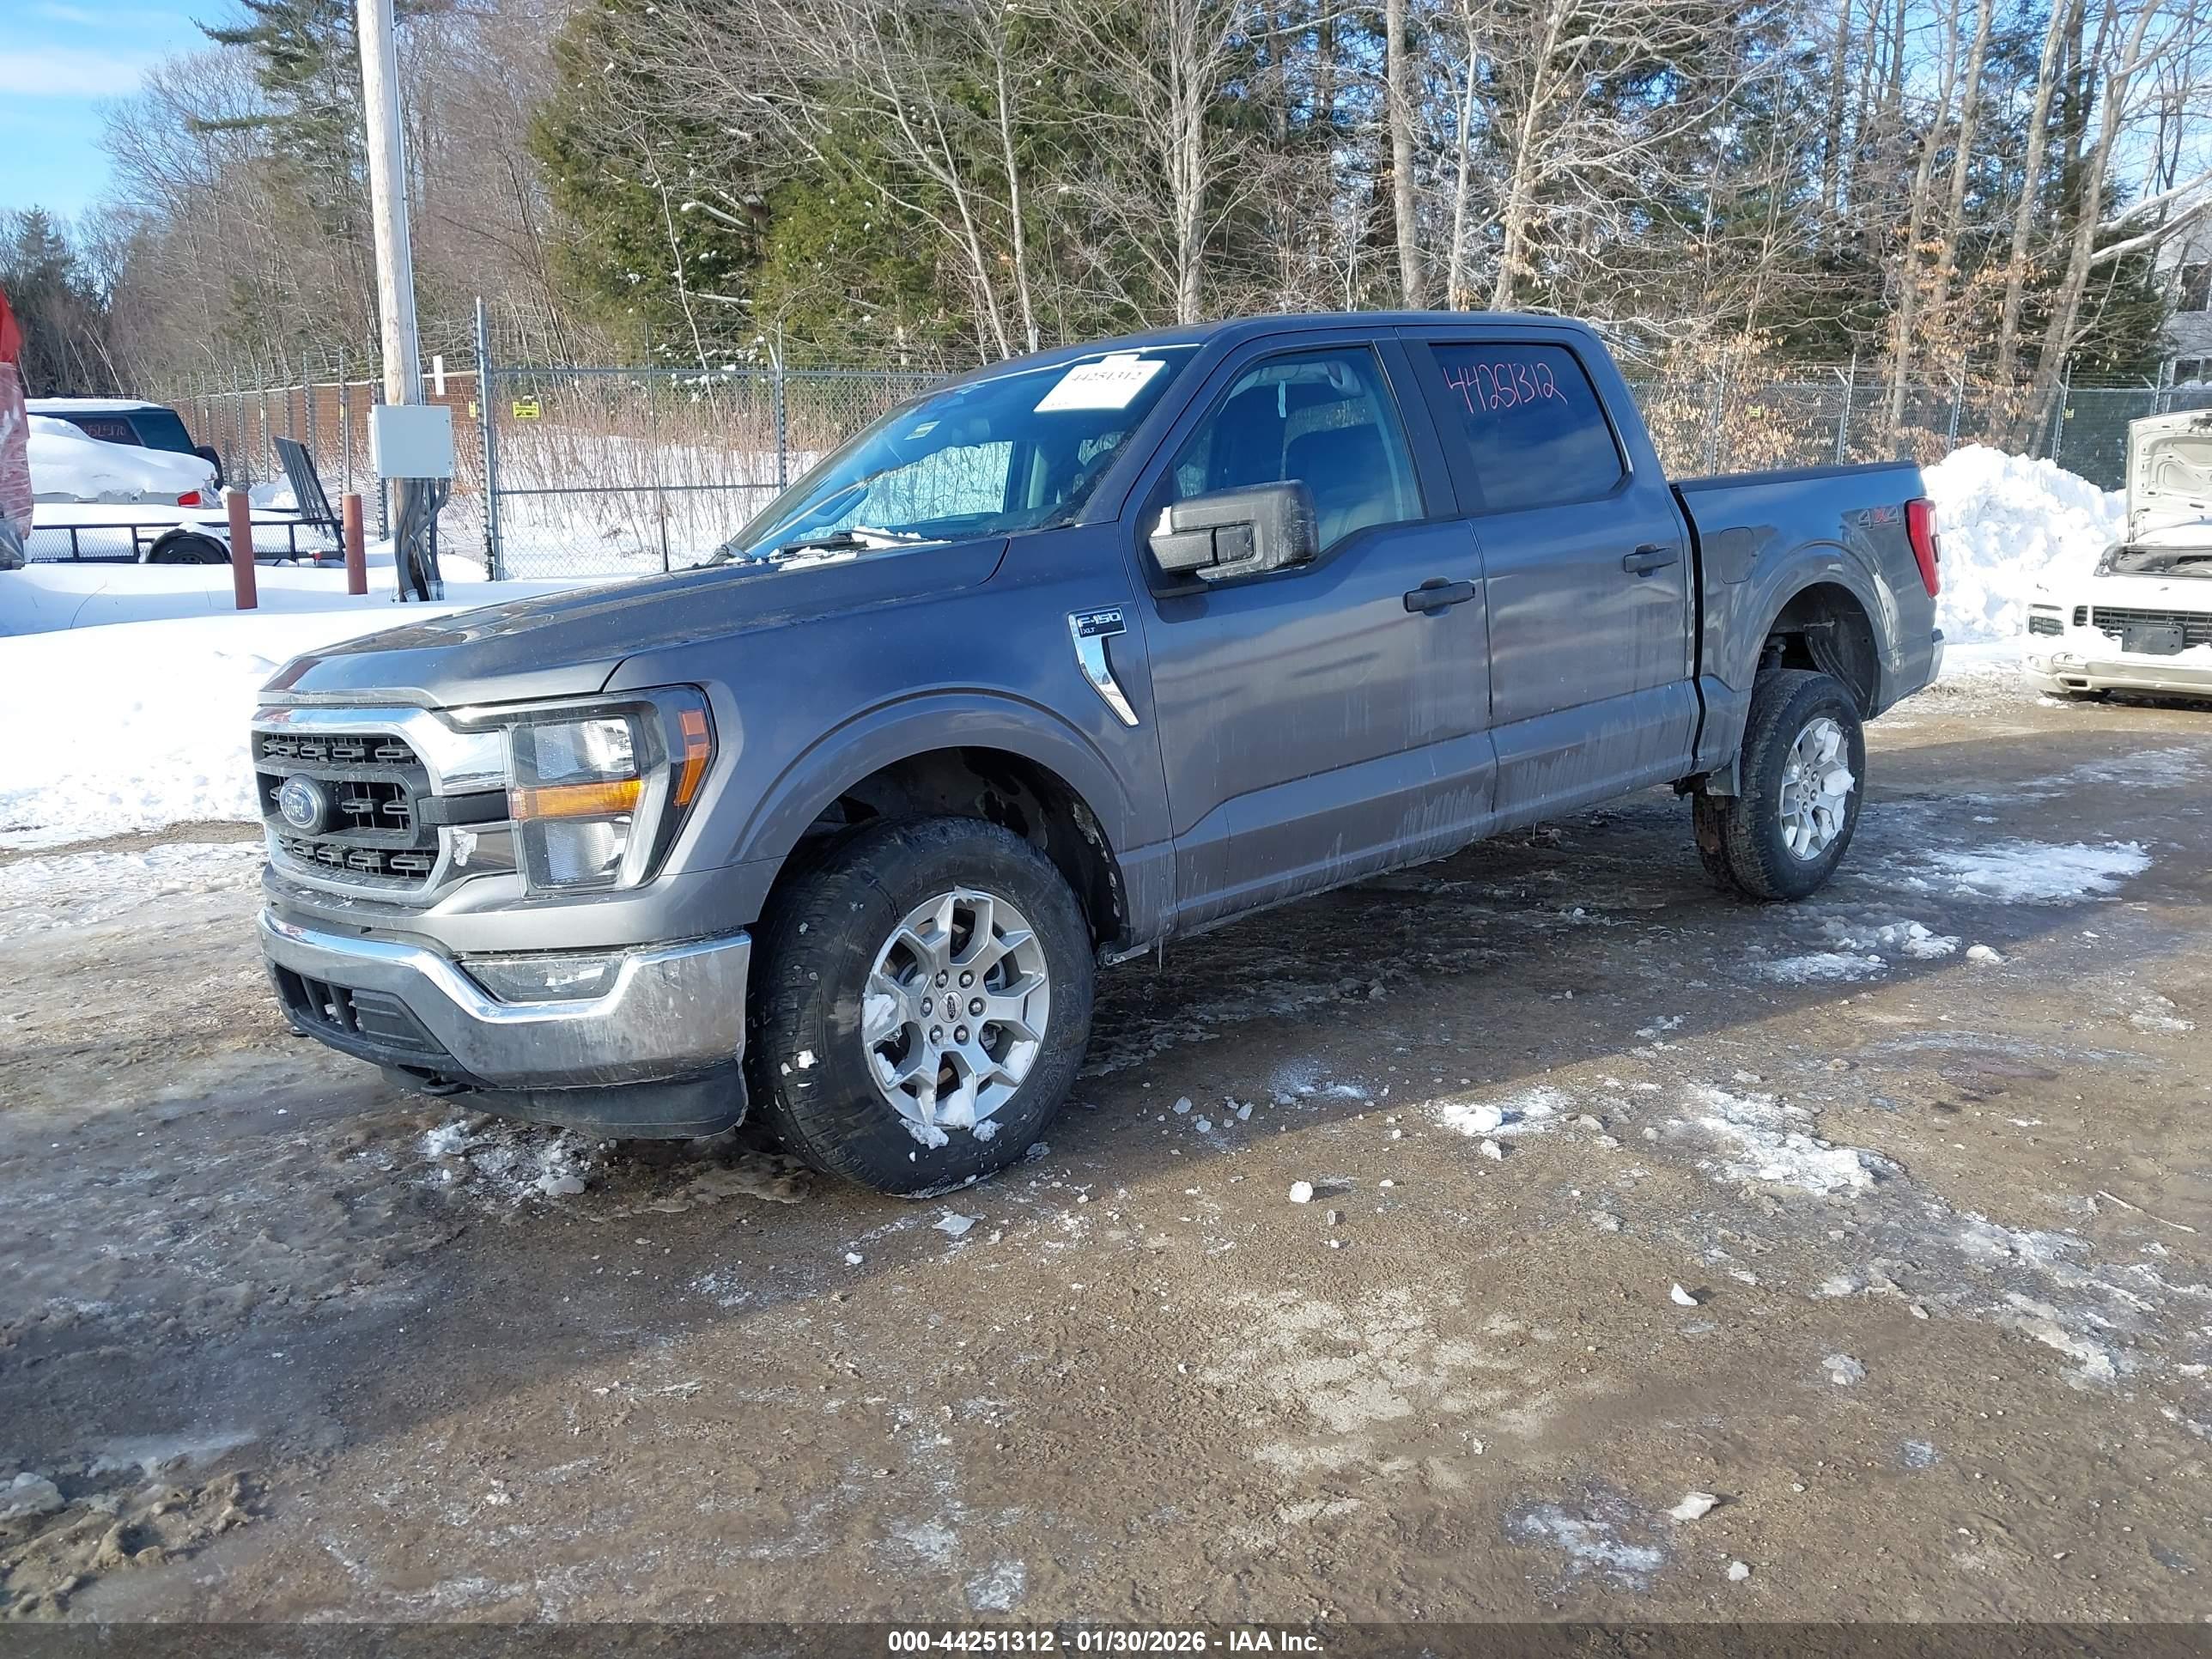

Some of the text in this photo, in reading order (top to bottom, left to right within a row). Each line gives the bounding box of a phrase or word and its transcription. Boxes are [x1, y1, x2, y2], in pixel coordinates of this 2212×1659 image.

[1443, 362, 1568, 414] 44251312
[1077, 611, 1121, 628] F-150
[284, 791, 305, 818] Ford
